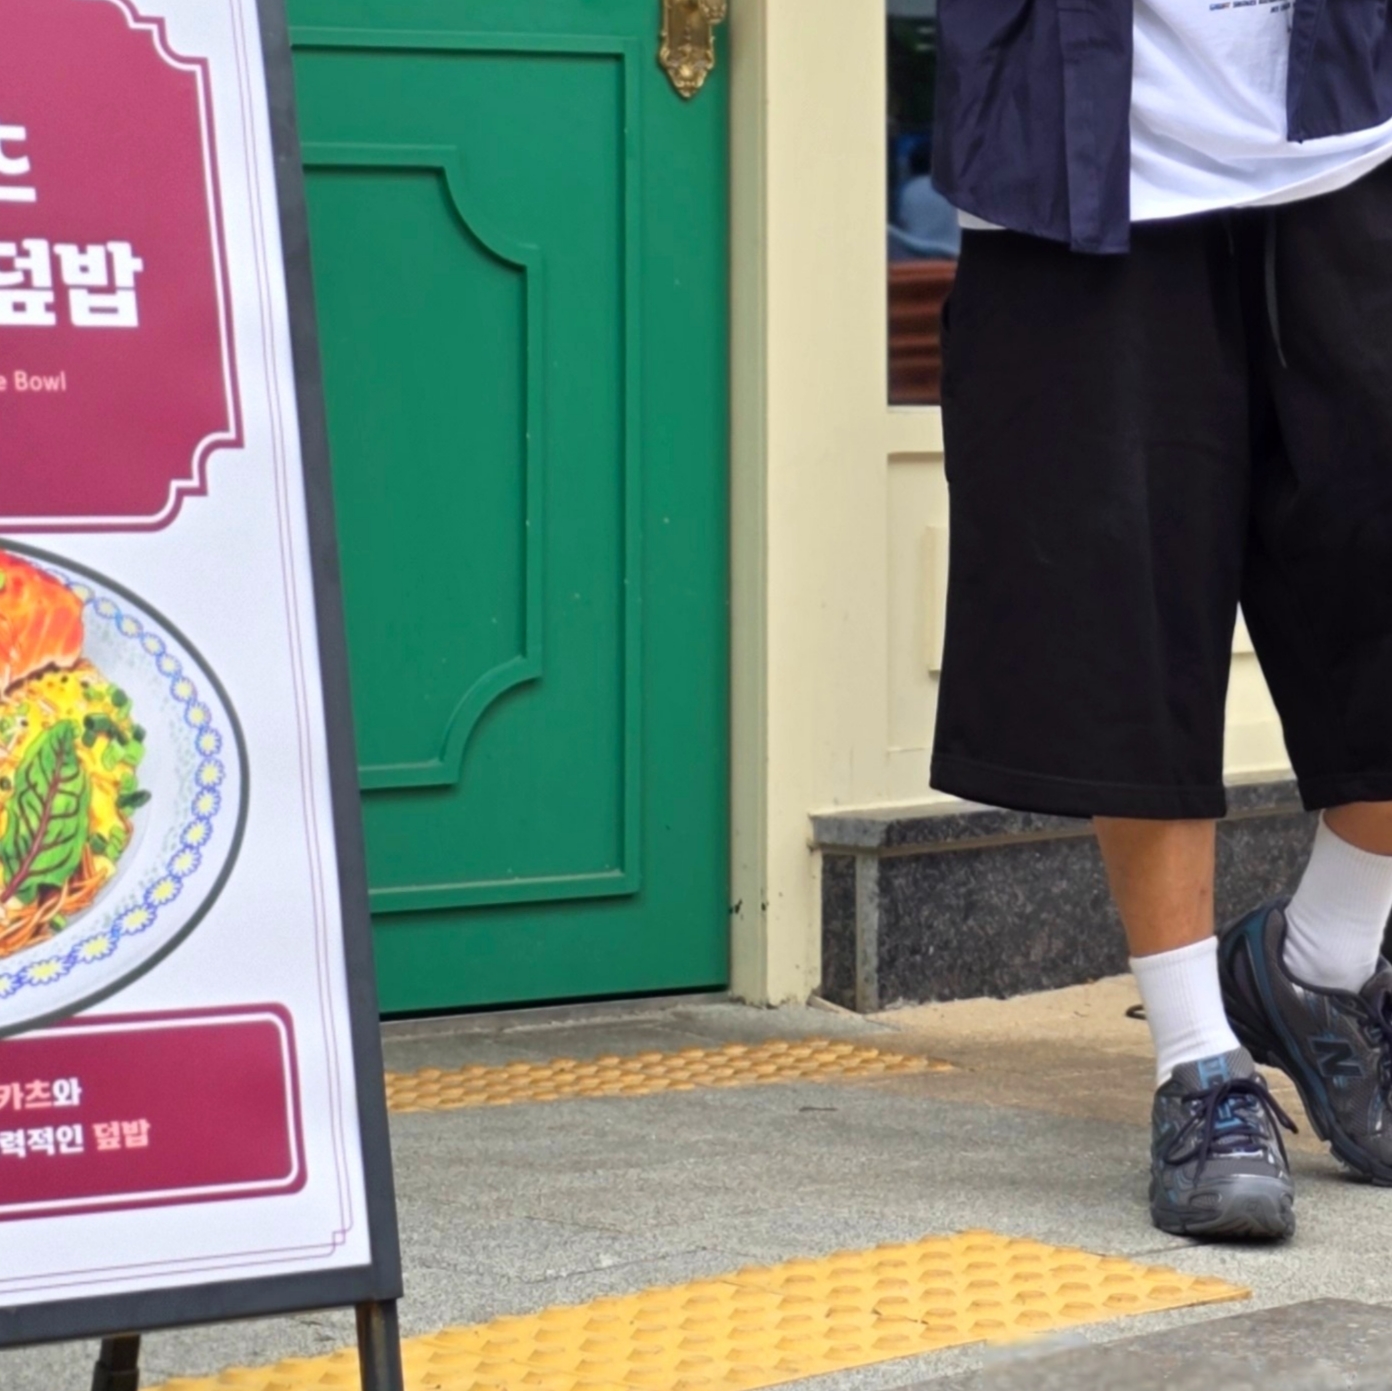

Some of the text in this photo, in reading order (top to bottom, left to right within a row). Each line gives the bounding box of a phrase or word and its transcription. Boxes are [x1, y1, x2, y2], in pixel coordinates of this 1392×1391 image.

[0, 238, 143, 328] 덮밥
[13, 369, 67, 392] Bowl
[0, 1077, 82, 1110] 카츠와
[0, 1118, 151, 1158] 력적인 덮밥
